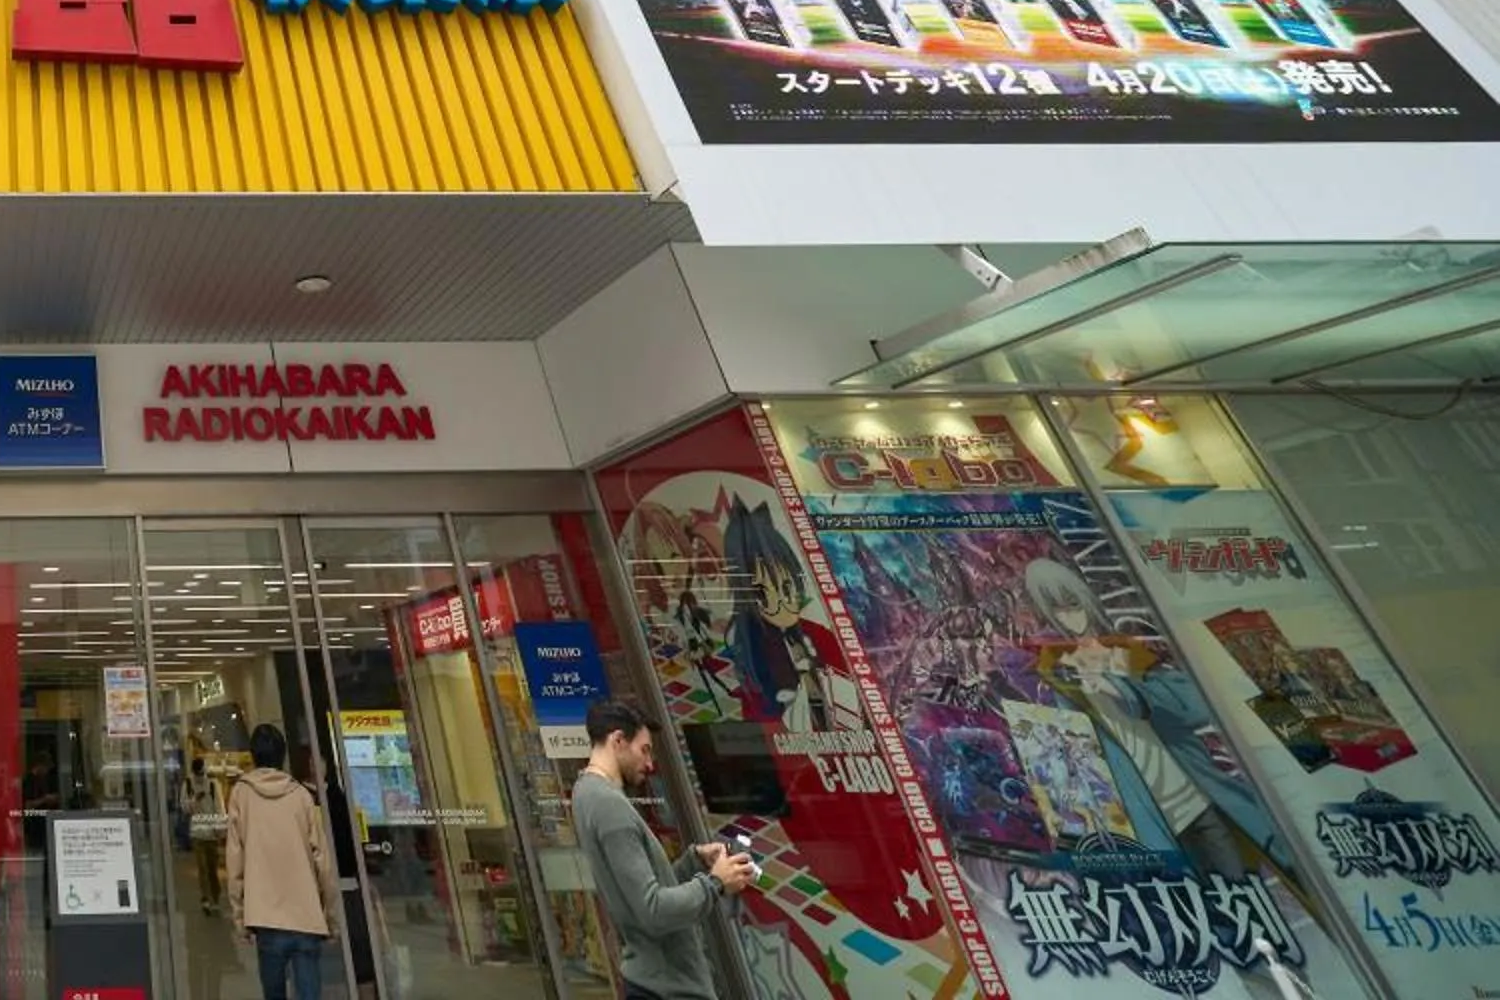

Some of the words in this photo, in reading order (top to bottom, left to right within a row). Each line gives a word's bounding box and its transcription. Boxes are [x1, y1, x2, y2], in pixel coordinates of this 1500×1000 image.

[15, 378, 76, 393] MIZUHO
[160, 363, 406, 399] AKIHABARA
[7, 422, 85, 436] ATMコーナー
[26, 406, 66, 421] みずほ
[143, 405, 436, 442] RADIOKAIKAN
[859, 680, 892, 724] SHOP
[879, 729, 915, 776] GAME
[901, 781, 937, 832] CARD
[965, 938, 1005, 996] SHOP
